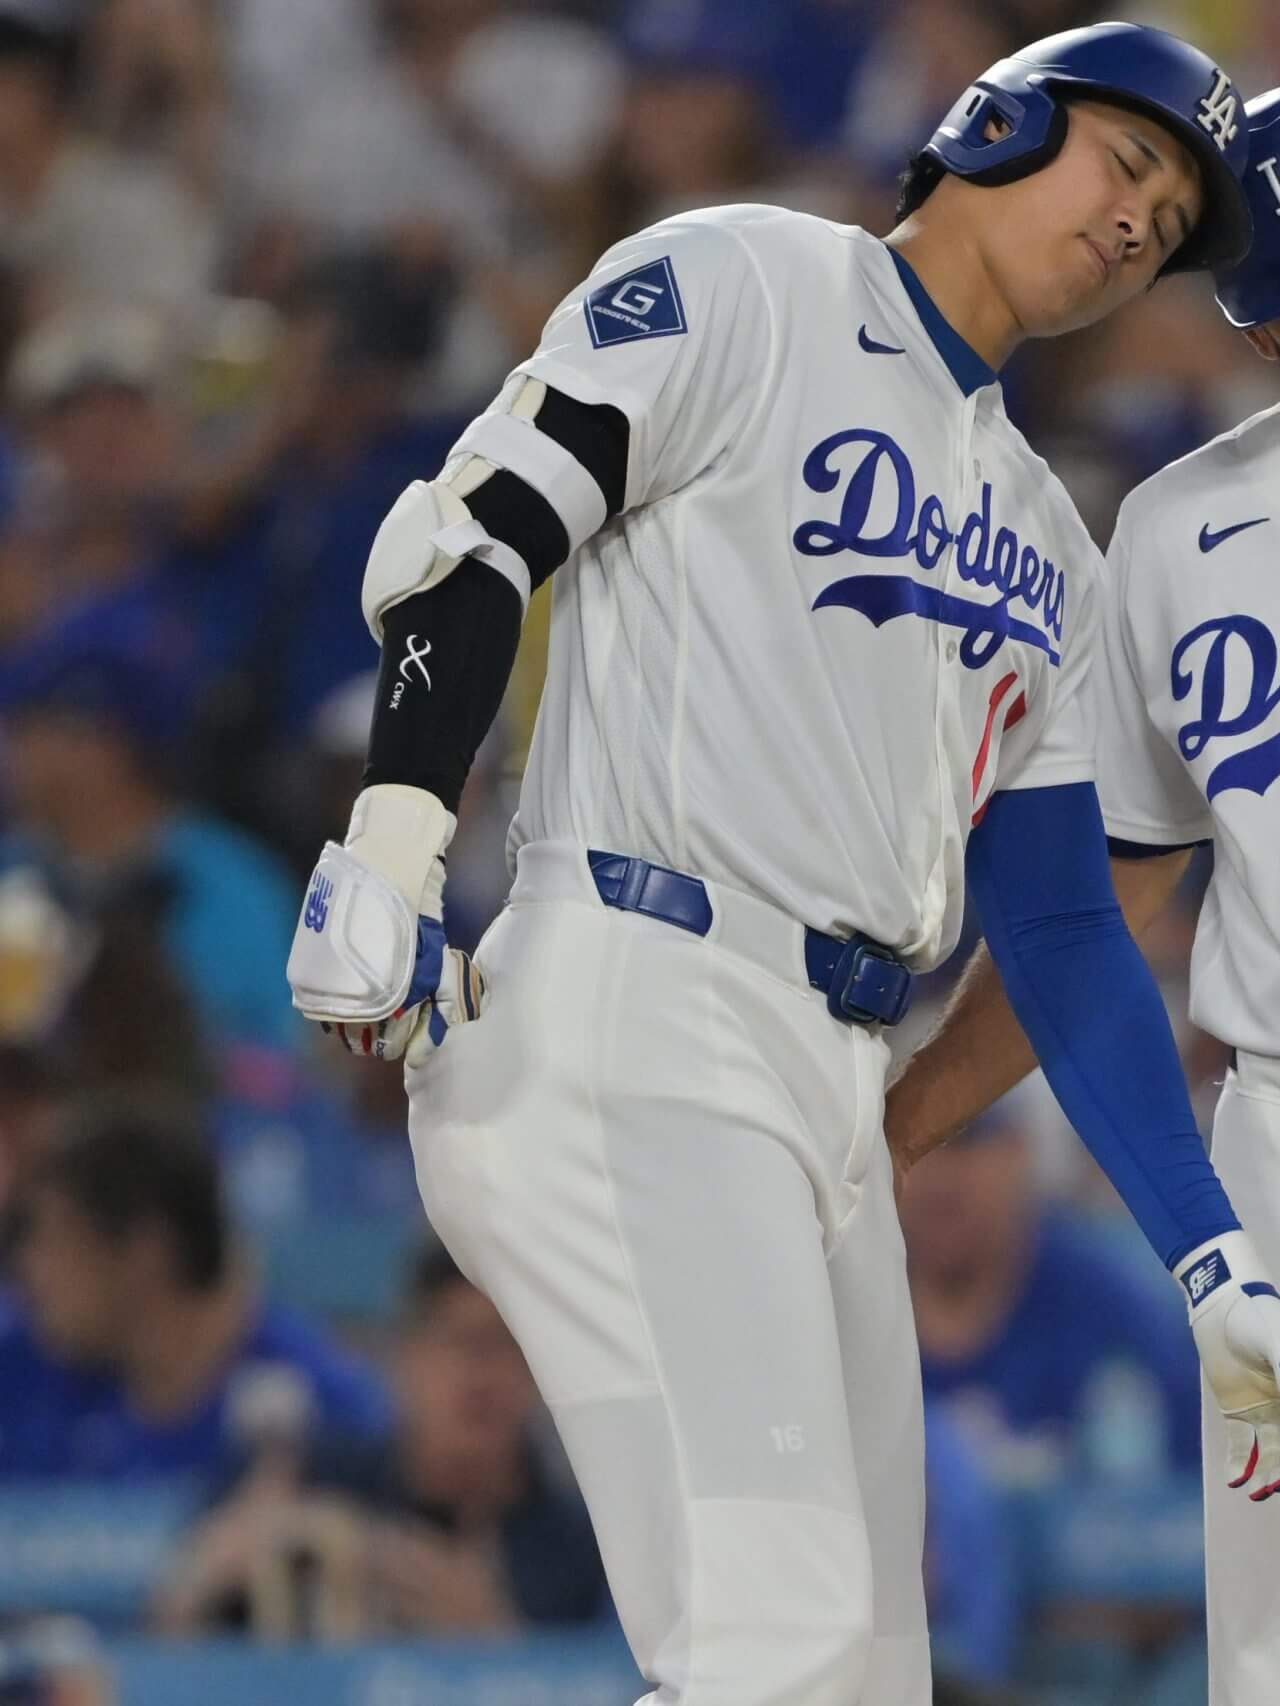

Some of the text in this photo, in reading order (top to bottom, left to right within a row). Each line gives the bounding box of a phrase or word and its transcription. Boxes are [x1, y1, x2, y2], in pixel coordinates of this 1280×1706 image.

[1197, 68, 1238, 150] LA
[611, 280, 664, 315] G
[793, 428, 1065, 671] Dodgers
[768, 1424, 806, 1454] 16
